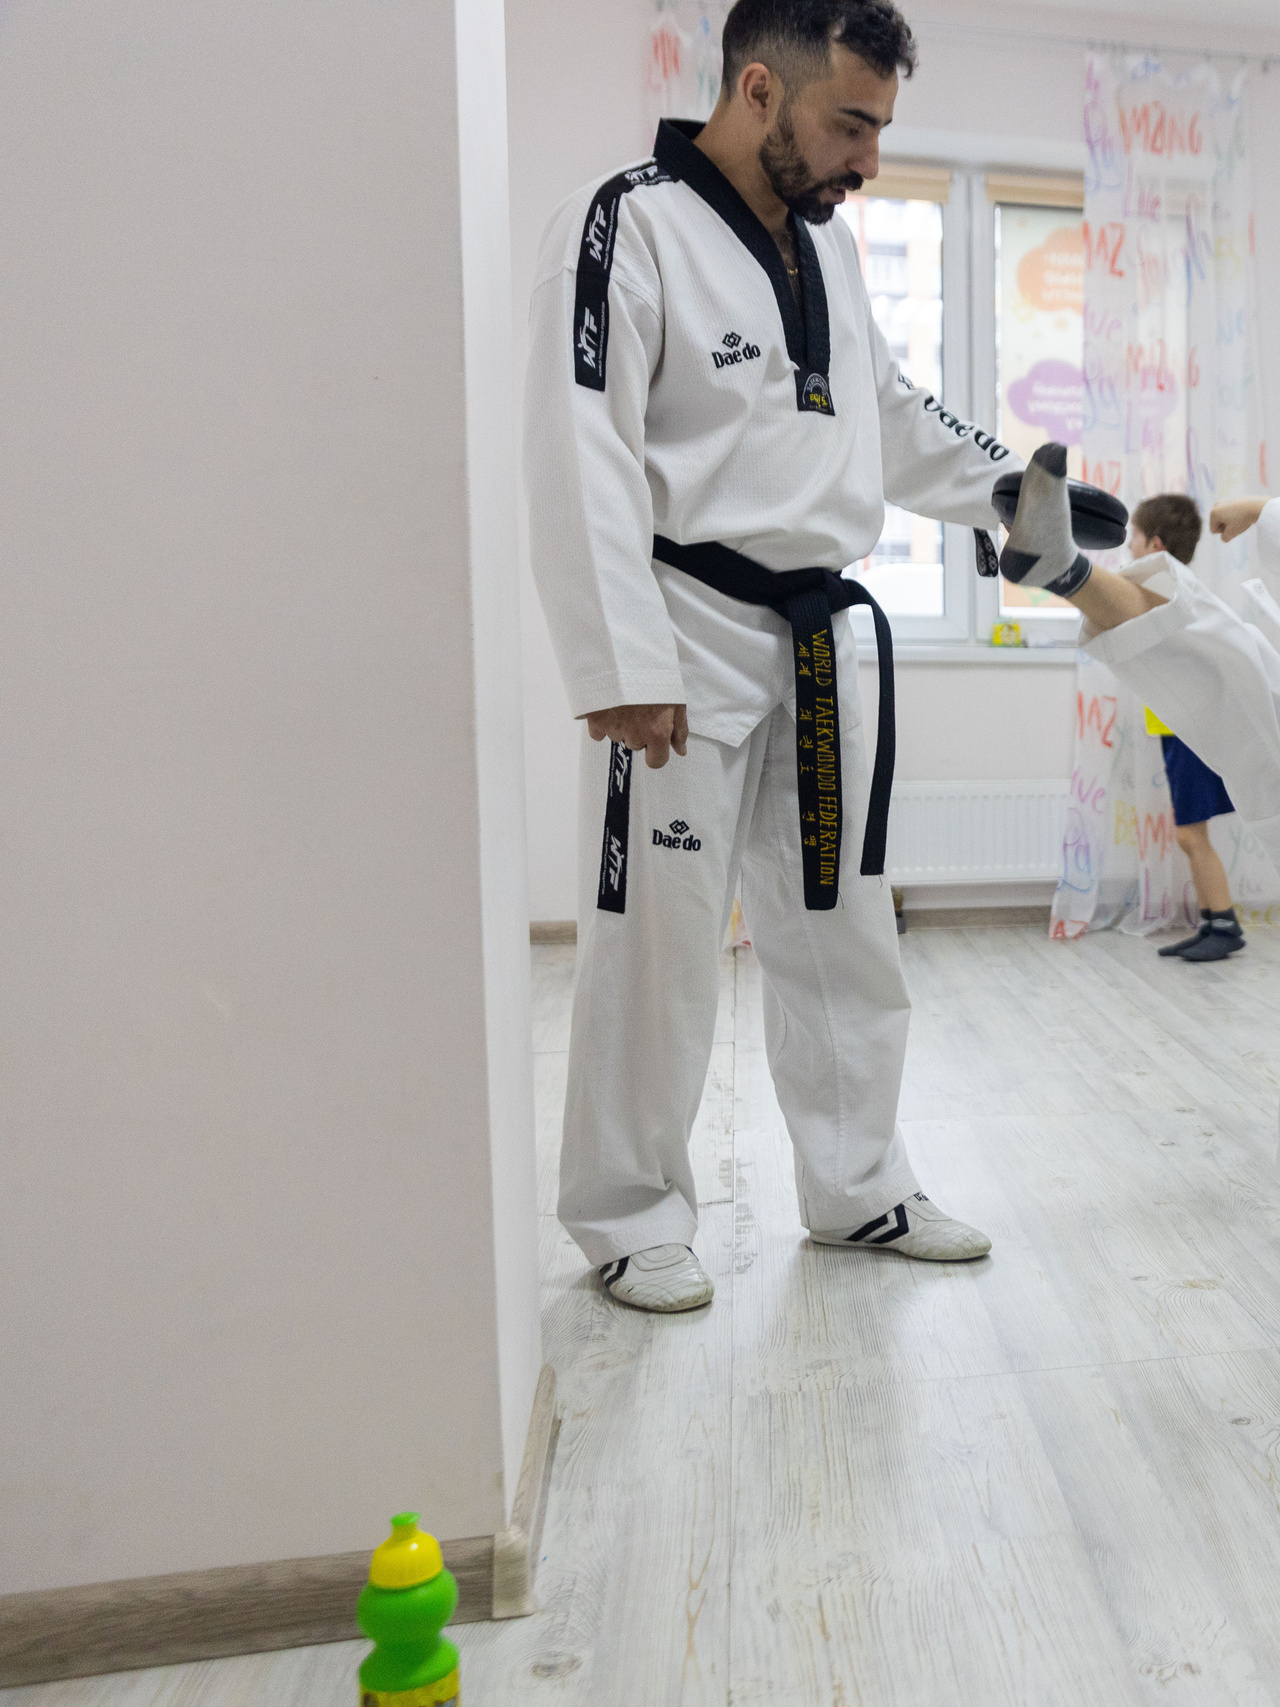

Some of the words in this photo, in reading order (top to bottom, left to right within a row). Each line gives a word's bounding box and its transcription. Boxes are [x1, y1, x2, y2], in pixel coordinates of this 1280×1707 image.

[586, 204, 606, 262] WTF
[577, 306, 597, 369] WTF
[812, 629, 832, 687] WORLD
[815, 696, 836, 791] TAEKWONDO
[608, 834, 625, 892] WTF
[818, 796, 838, 886] FEDERATION
